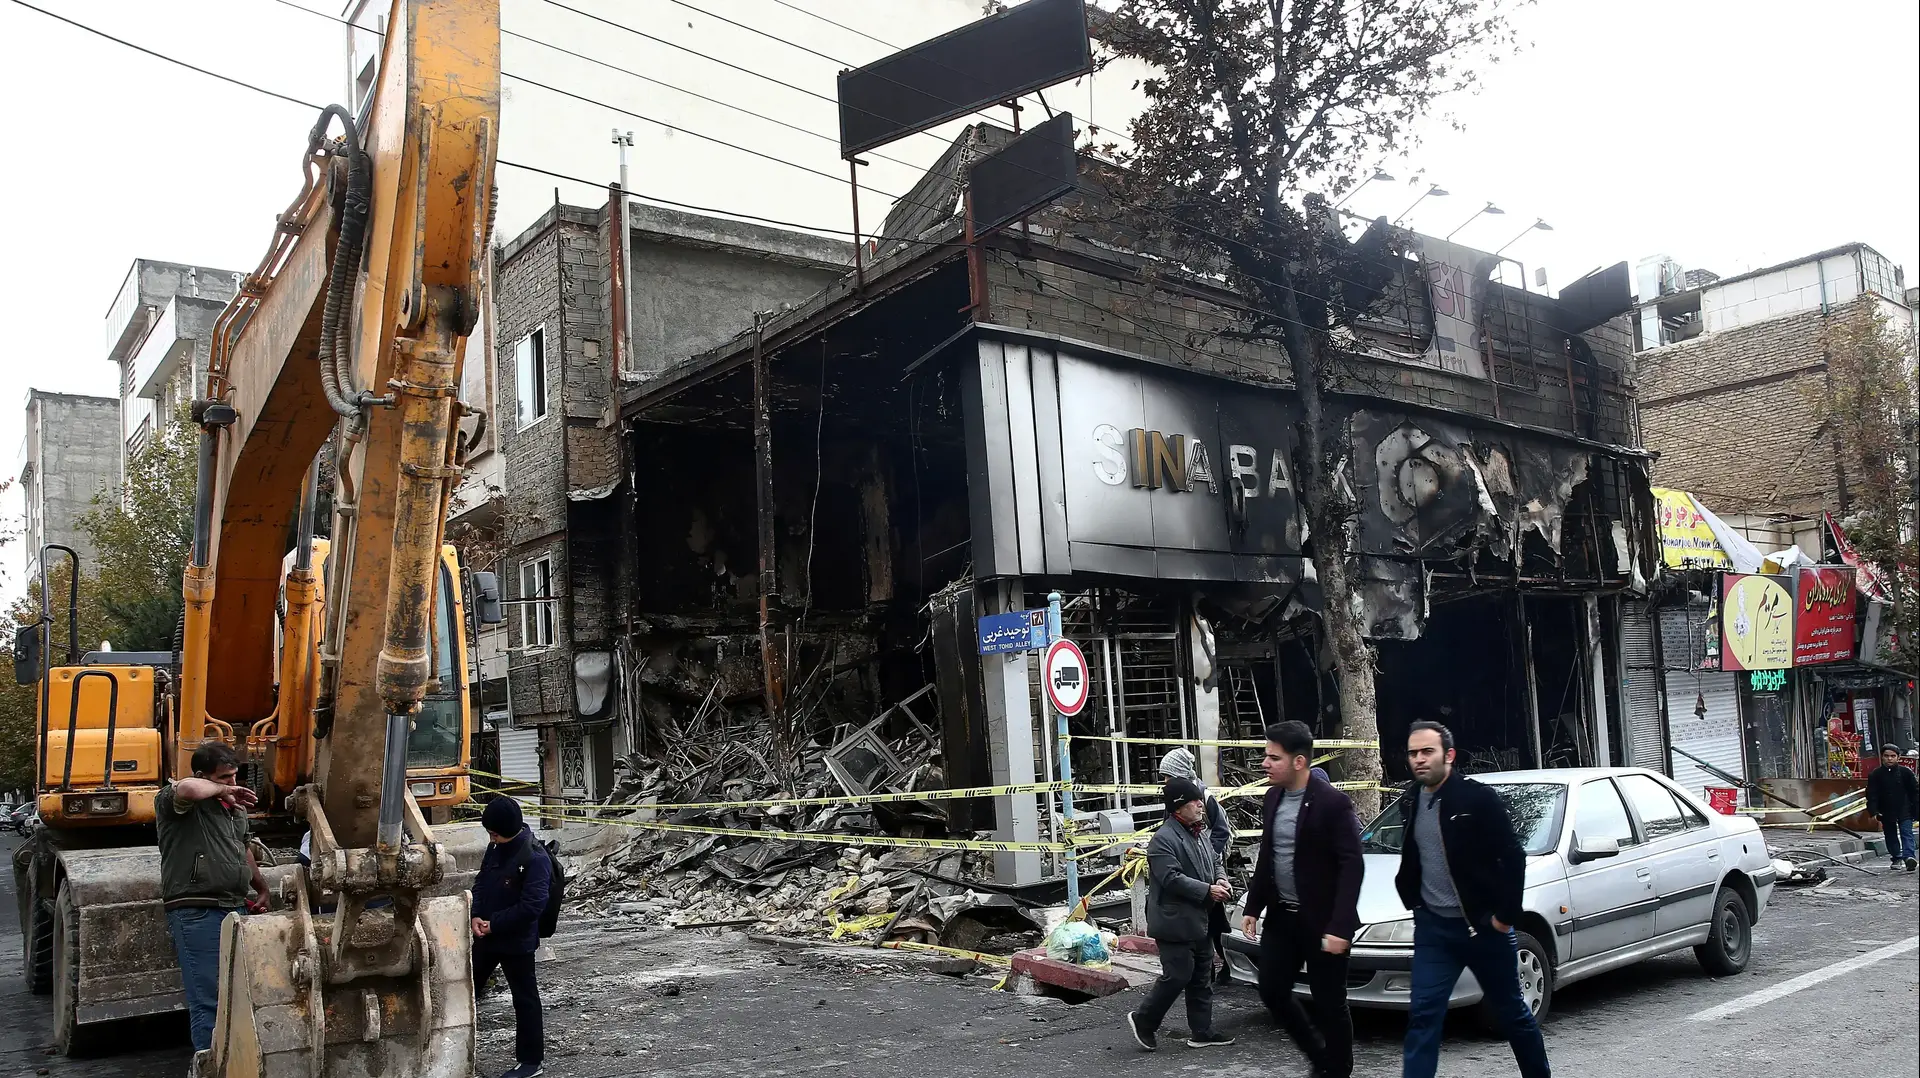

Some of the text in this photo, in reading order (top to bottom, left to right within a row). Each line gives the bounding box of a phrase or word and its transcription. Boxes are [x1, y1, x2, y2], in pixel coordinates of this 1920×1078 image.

[1229, 443, 1357, 503] BAK
[982, 622, 1030, 644] توحید غربی
[983, 644, 997, 652] WEST
[999, 642, 1014, 650] TOHID
[1015, 640, 1031, 648] ALLEY
